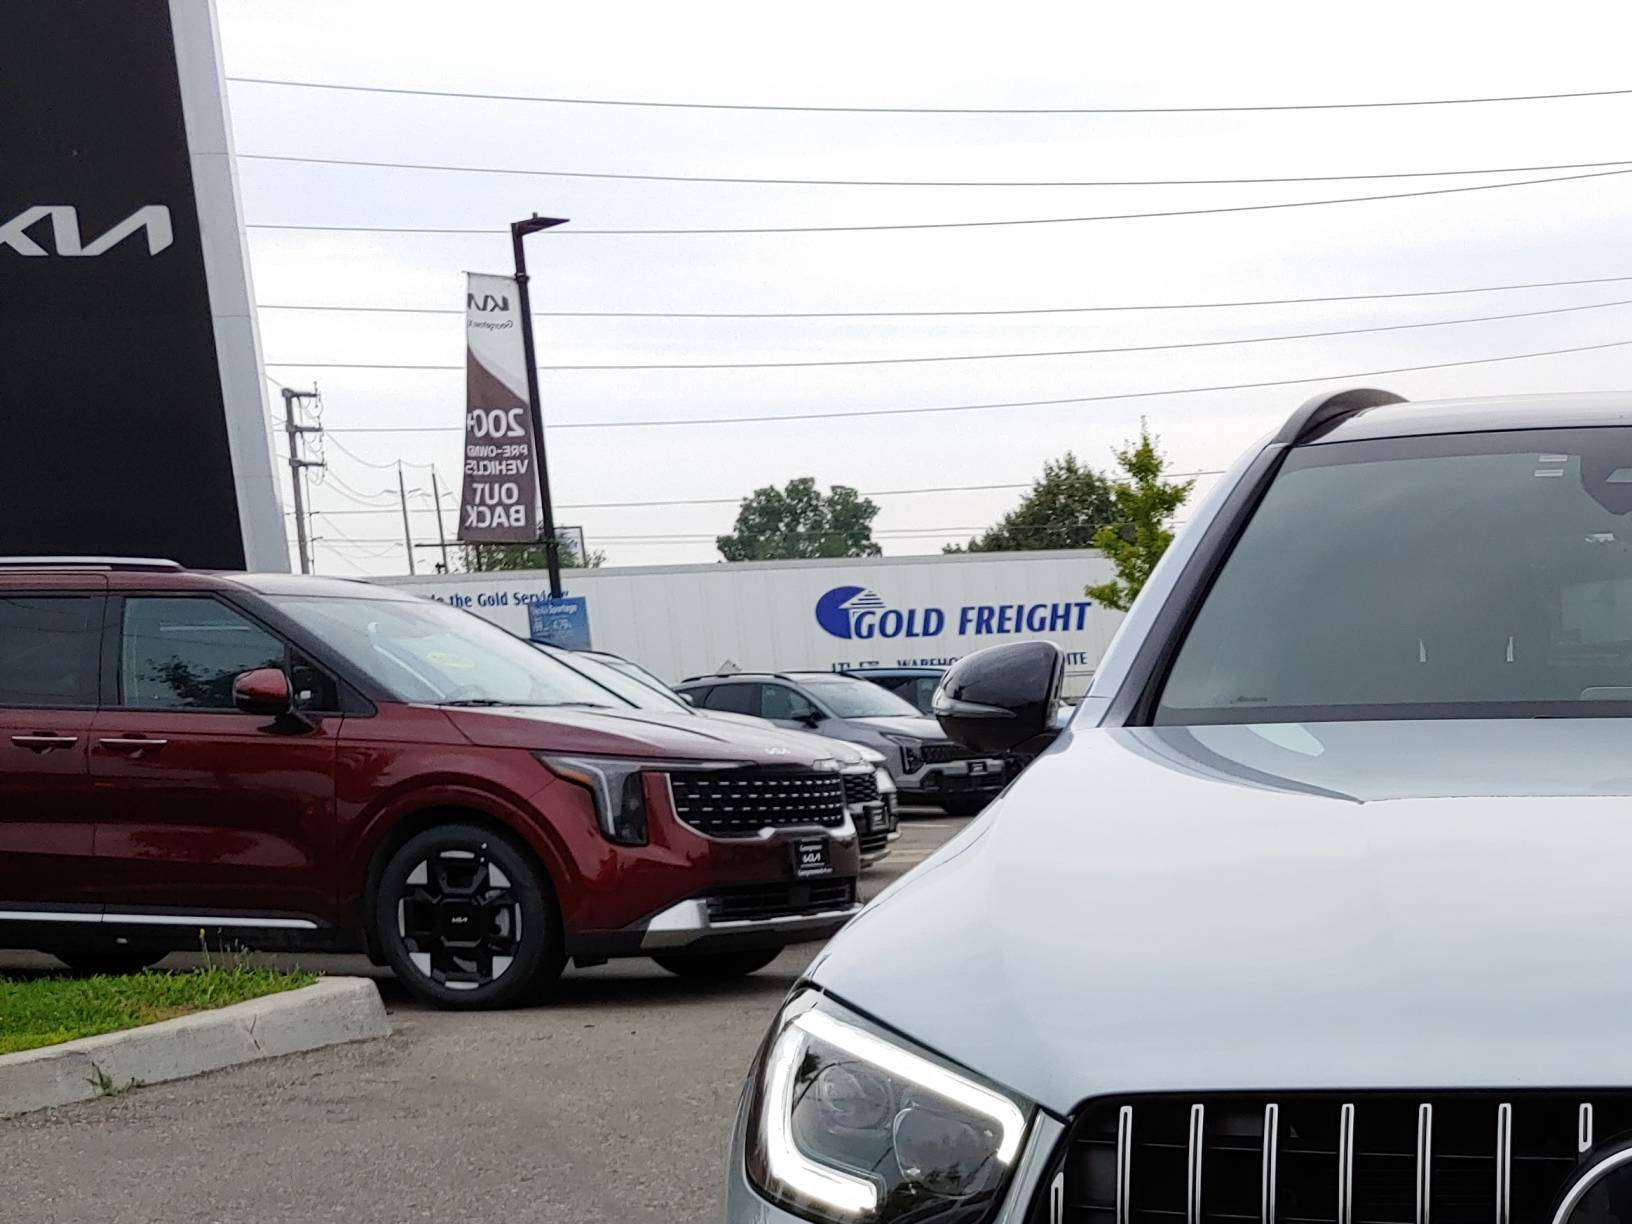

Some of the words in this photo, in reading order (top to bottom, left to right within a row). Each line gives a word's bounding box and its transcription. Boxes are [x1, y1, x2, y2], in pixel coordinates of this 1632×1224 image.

[450, 592, 473, 608] the
[477, 591, 509, 607] Gold
[853, 608, 945, 640] GOLD
[958, 602, 1092, 636] FREIGHT
